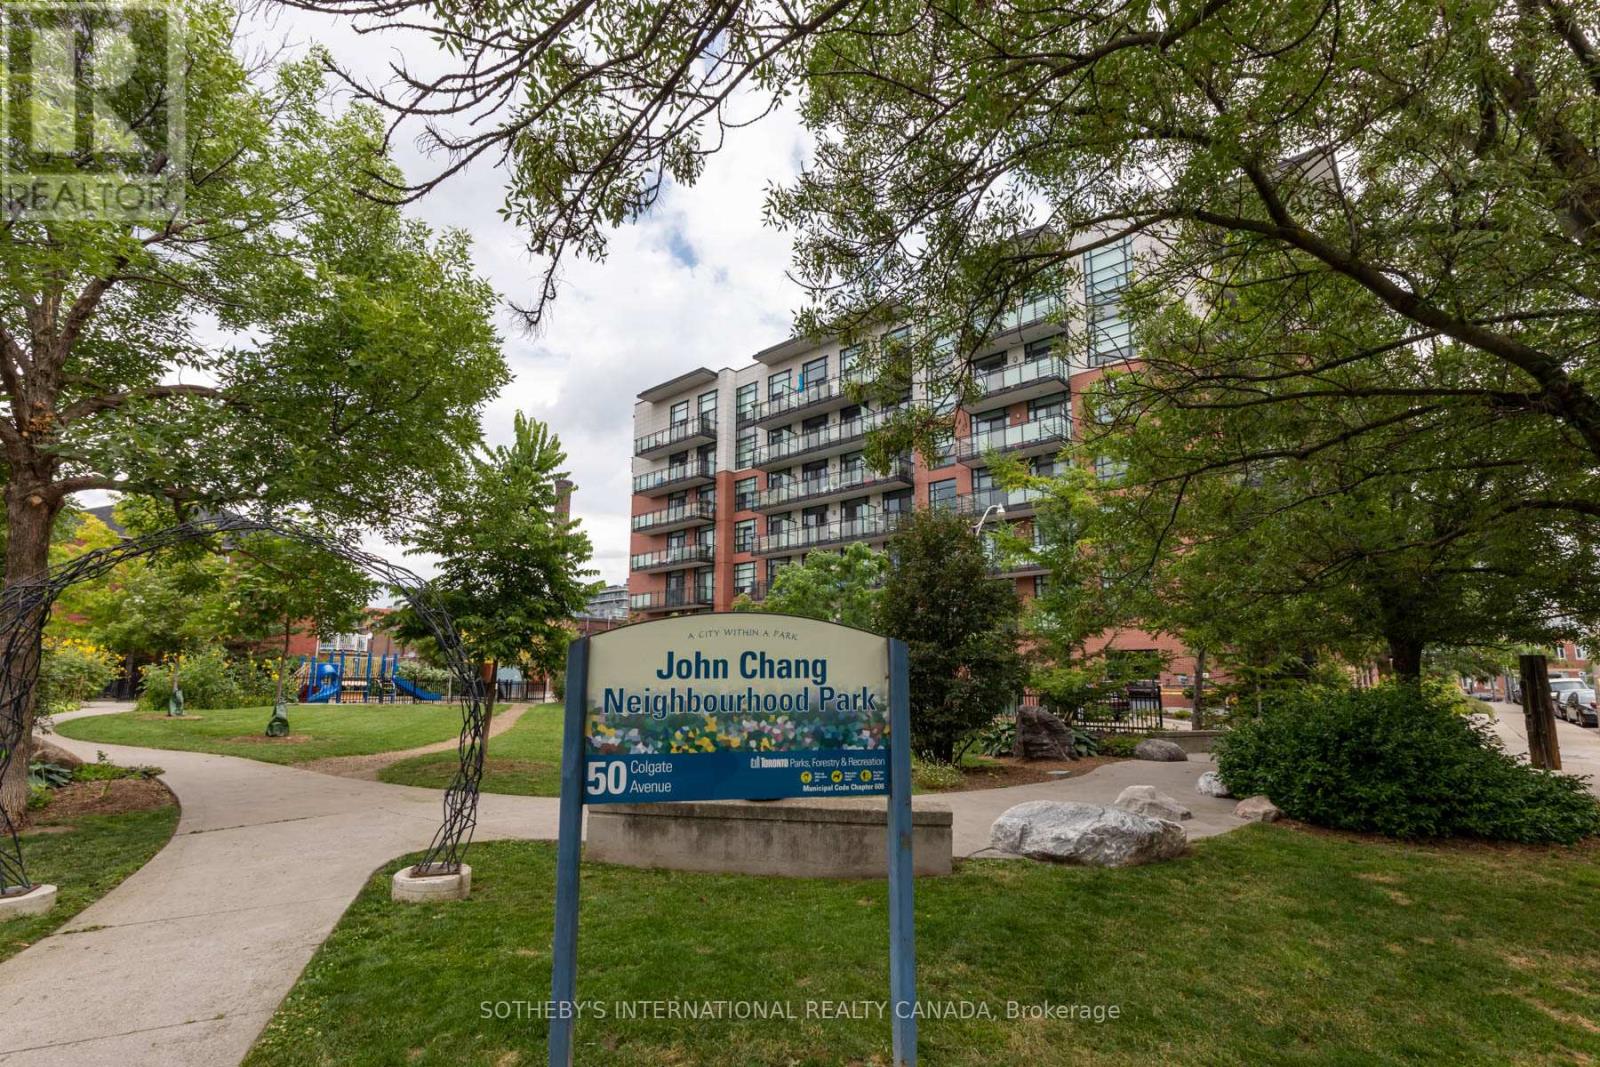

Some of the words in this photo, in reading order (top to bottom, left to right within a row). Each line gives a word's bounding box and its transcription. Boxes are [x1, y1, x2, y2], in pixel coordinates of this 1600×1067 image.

[688, 632, 695, 640] A
[699, 629, 719, 639] CITY
[724, 628, 759, 637] WITHIN
[763, 629, 769, 637] A
[774, 629, 798, 640] PARK
[656, 650, 729, 679] John
[739, 650, 827, 685] Chang
[603, 687, 810, 720] Neighbourhood
[818, 686, 877, 712] Park
[630, 760, 673, 775] Colgate
[761, 757, 789, 768] TORONTO
[790, 758, 812, 768] Parks,
[812, 758, 840, 768] Forestry
[841, 758, 847, 766] &
[848, 757, 885, 766] Recreation
[587, 760, 627, 795] 50
[629, 780, 672, 793] Avenue
[850, 783, 873, 791] Chapter
